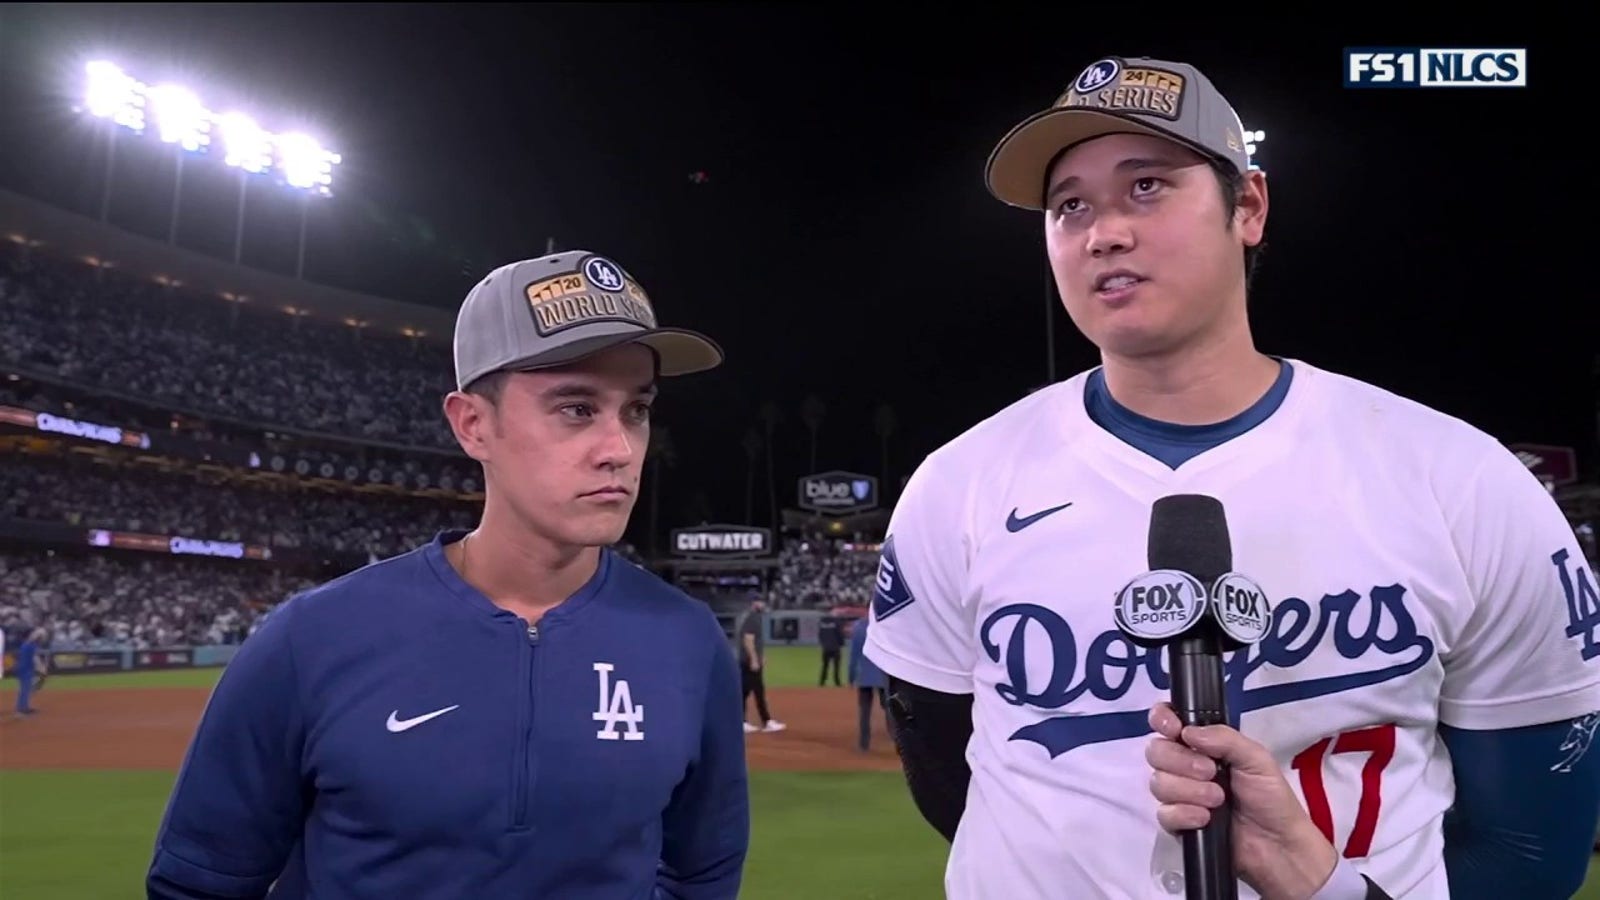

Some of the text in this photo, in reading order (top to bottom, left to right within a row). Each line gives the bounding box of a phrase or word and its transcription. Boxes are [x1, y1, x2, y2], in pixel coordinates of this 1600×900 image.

[1083, 64, 1105, 88] LA
[1125, 71, 1144, 82] 24
[1098, 87, 1176, 115] SERIES
[563, 275, 581, 290] 20
[592, 261, 619, 288] LA
[536, 294, 617, 329] WORLD
[806, 480, 850, 498] blue
[677, 533, 764, 551] CUTWATER
[1131, 582, 1185, 613] FOX
[1224, 584, 1261, 619] FOX
[1131, 609, 1187, 625] SPORTS
[1225, 612, 1263, 631] SPORTS
[592, 662, 644, 740] LA
[1291, 723, 1396, 859] 17
